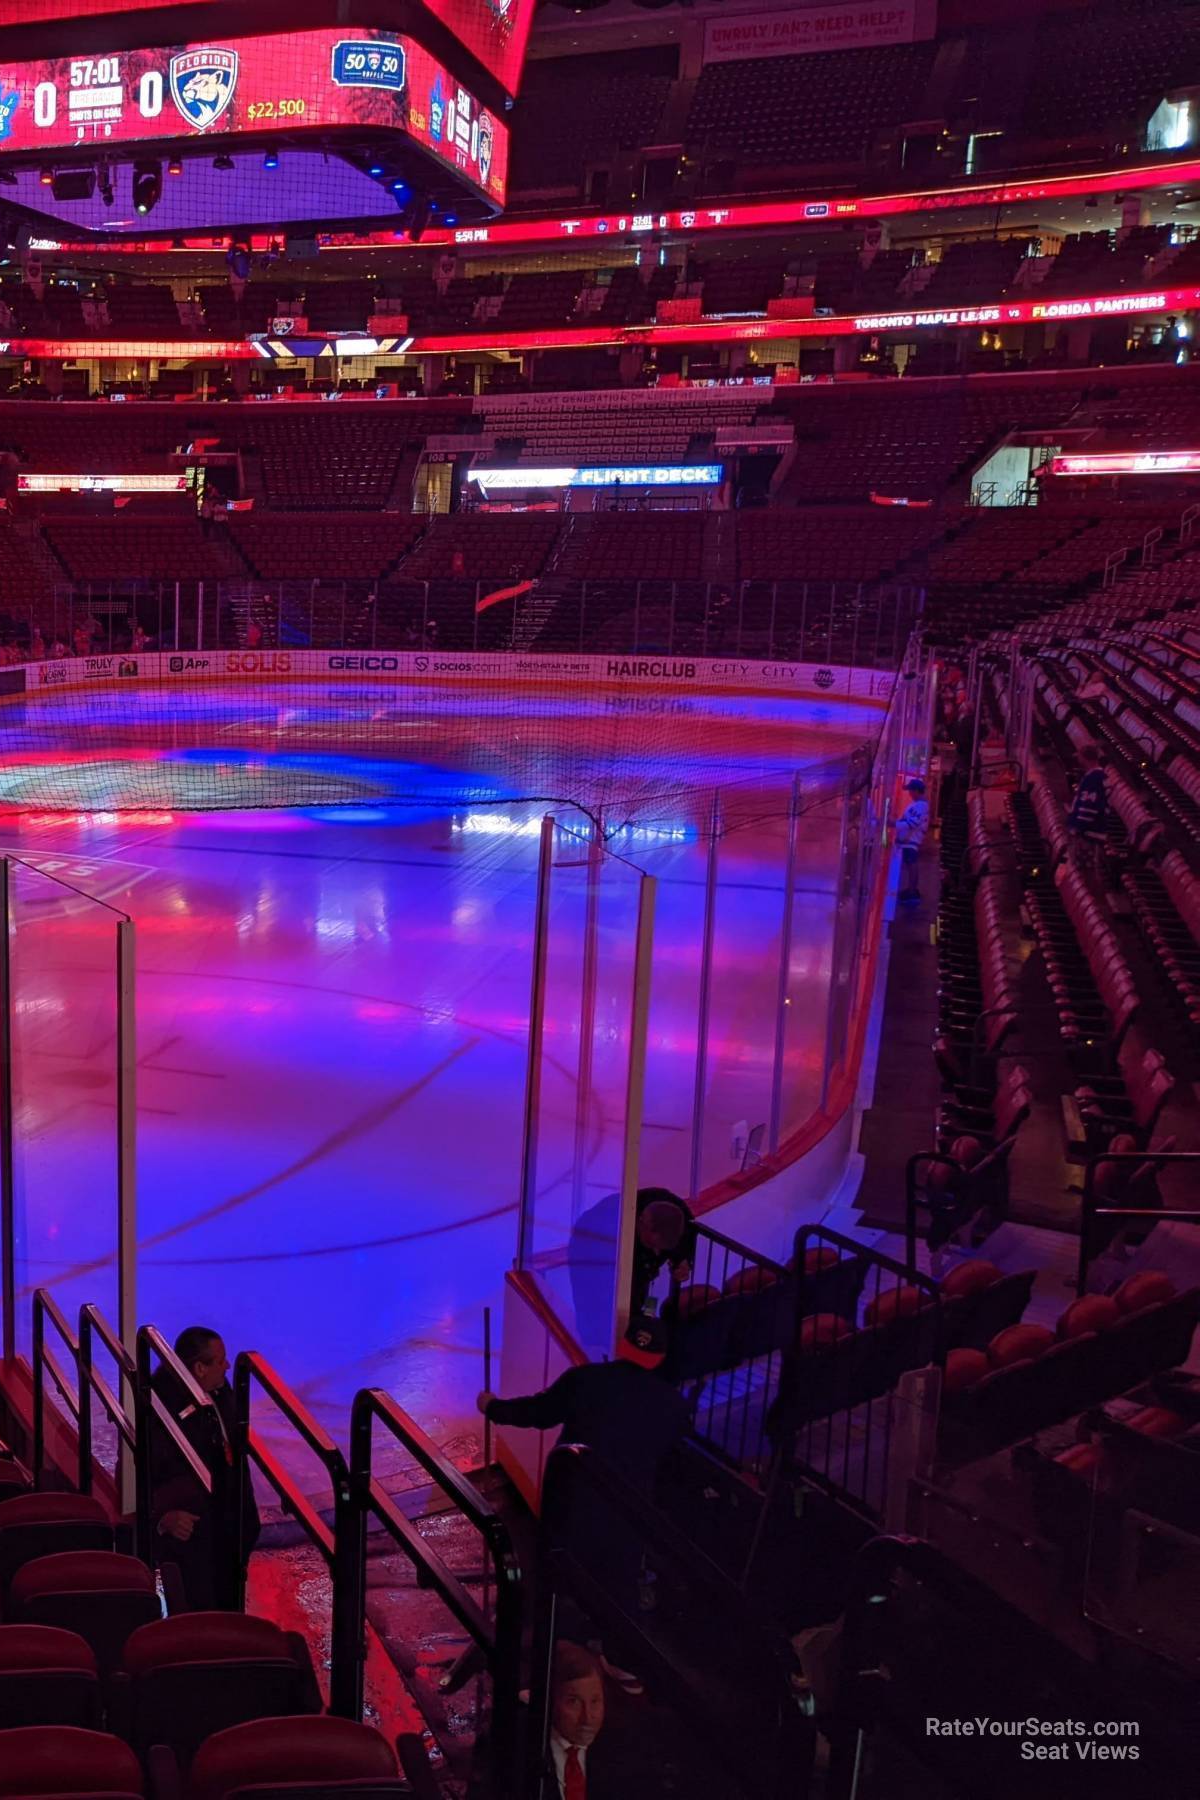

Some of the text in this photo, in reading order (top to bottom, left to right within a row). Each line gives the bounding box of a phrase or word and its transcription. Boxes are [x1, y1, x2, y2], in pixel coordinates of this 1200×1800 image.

[712, 24, 768, 42] UNRULY
[815, 15, 855, 32] NEED
[179, 54, 229, 70] FLORIDA
[345, 54, 398, 73] 50 50
[70, 57, 121, 86] 57:01
[140, 71, 163, 117] 0
[34, 82, 57, 127] 0
[247, 100, 305, 121] $22,500
[69, 106, 122, 122] SHOTS ON GOAL
[474, 229, 488, 241] PM
[854, 315, 913, 329] TORONTO
[916, 312, 958, 326] MAPLE
[961, 308, 1000, 322] LEAFS
[1032, 302, 1091, 318] FLORIDA
[1094, 295, 1166, 312] PANTHERS
[581, 467, 711, 484] FLIGHT DECK
[85, 658, 113, 670] TRULY
[226, 653, 292, 673] SOLIS
[328, 656, 399, 671] GEICO
[606, 661, 696, 678] HAIRCLUB
[711, 663, 750, 675] CITY
[761, 665, 798, 678] CITY
